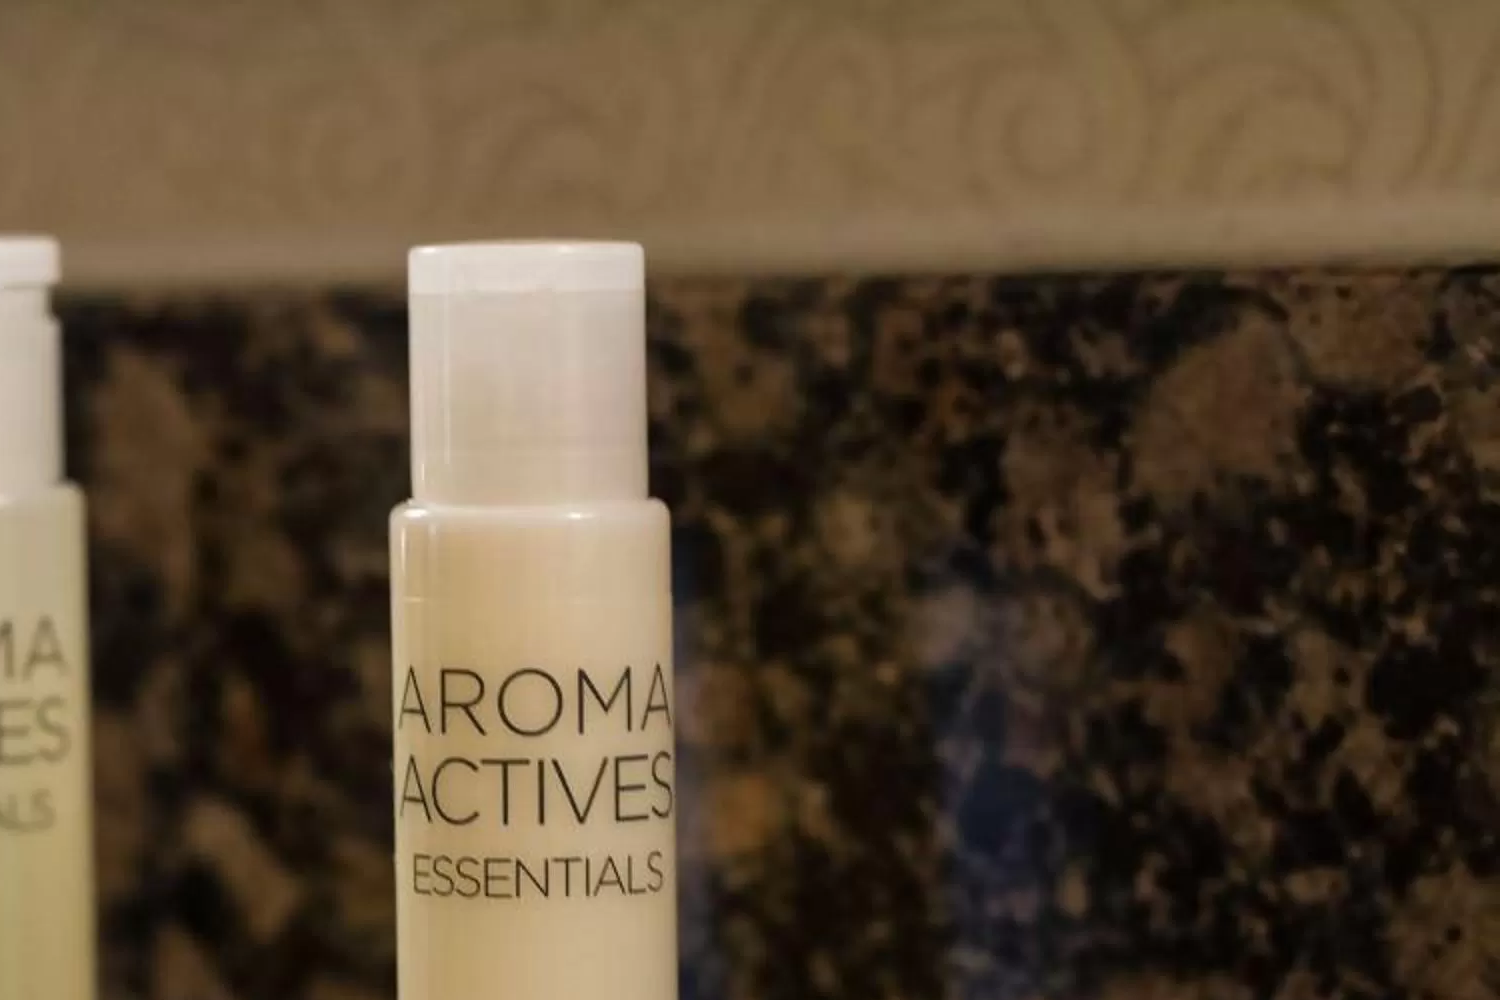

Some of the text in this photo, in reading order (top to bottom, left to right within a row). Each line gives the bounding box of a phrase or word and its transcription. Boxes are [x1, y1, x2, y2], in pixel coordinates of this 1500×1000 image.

[398, 663, 671, 737] AROMA
[399, 751, 673, 826] ACTIVES
[413, 851, 664, 899] ESSENTIALS
